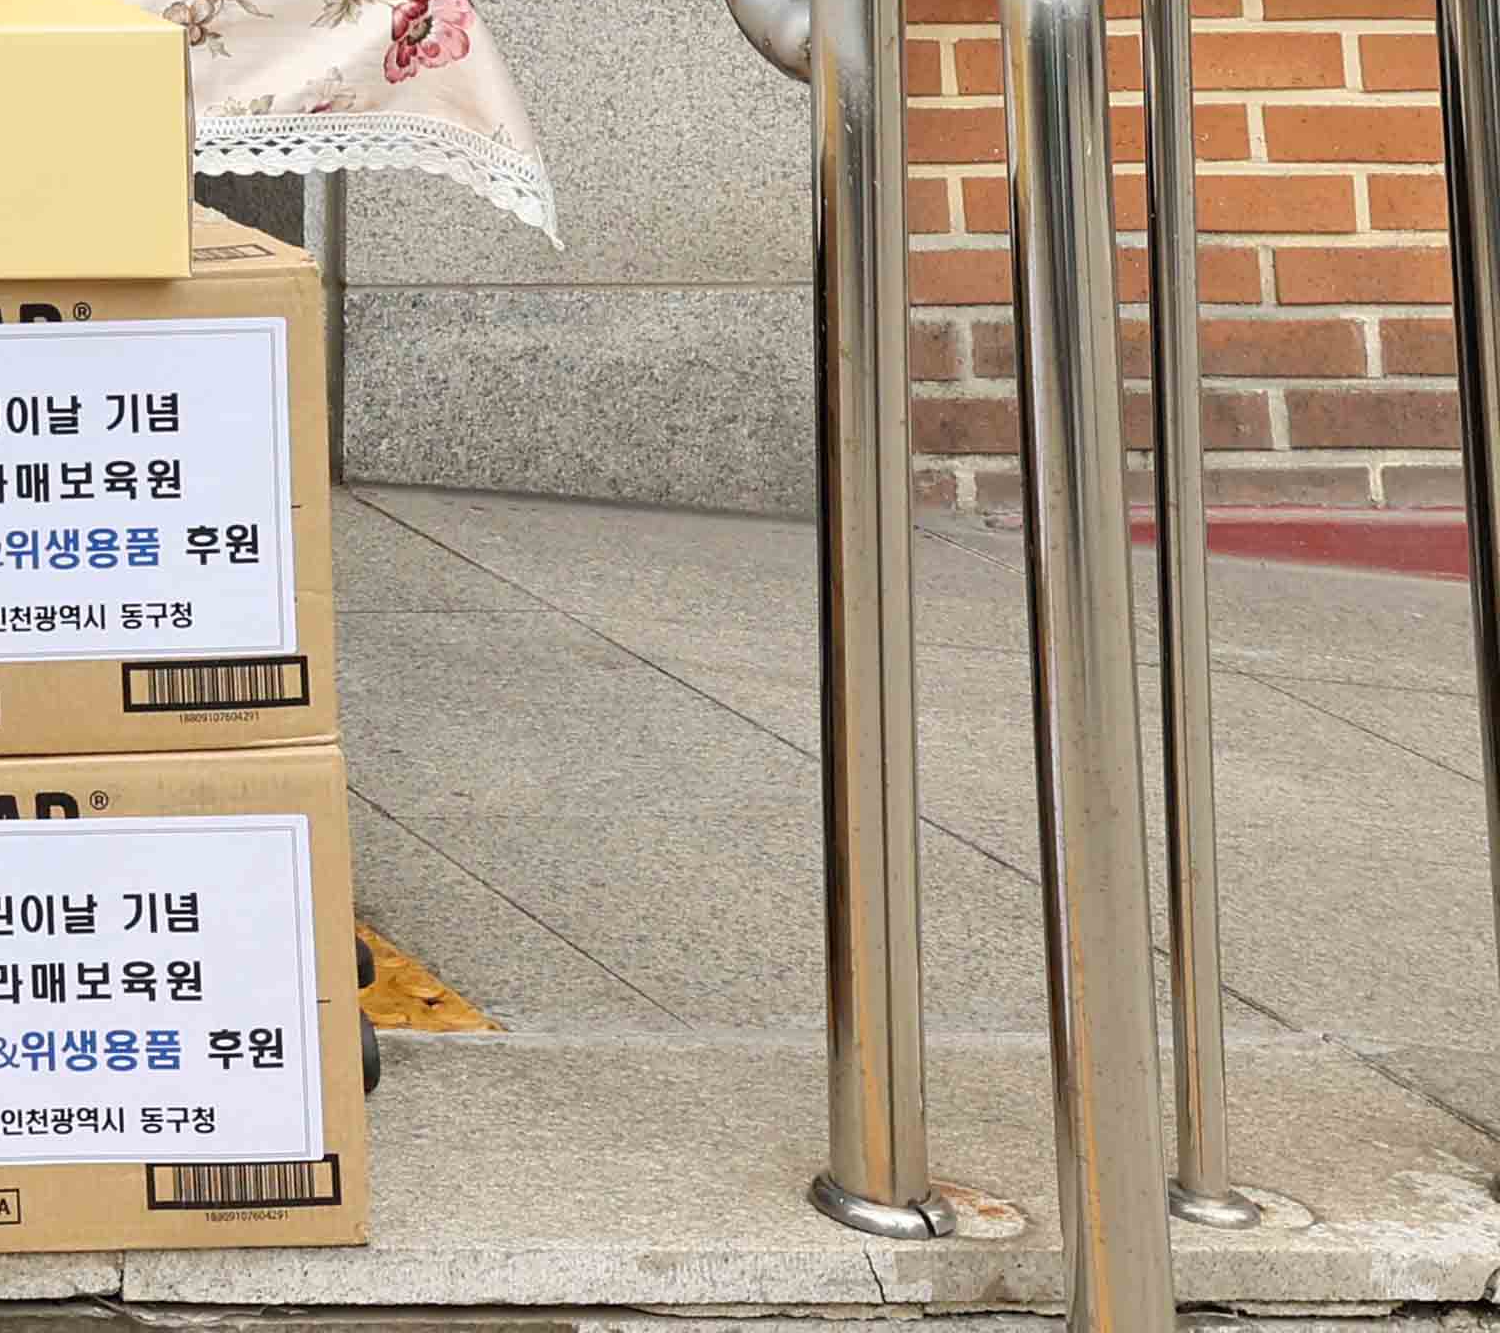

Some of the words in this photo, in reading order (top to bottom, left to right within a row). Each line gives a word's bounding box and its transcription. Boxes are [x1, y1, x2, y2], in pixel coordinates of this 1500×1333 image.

[106, 393, 178, 433] 기념
[186, 525, 258, 565] 후원
[121, 602, 192, 629] 동구청
[123, 893, 199, 933] 기념
[209, 1028, 283, 1069] 후원
[1, 1107, 124, 1135] 인천광역시
[141, 1107, 214, 1133] 동구청
